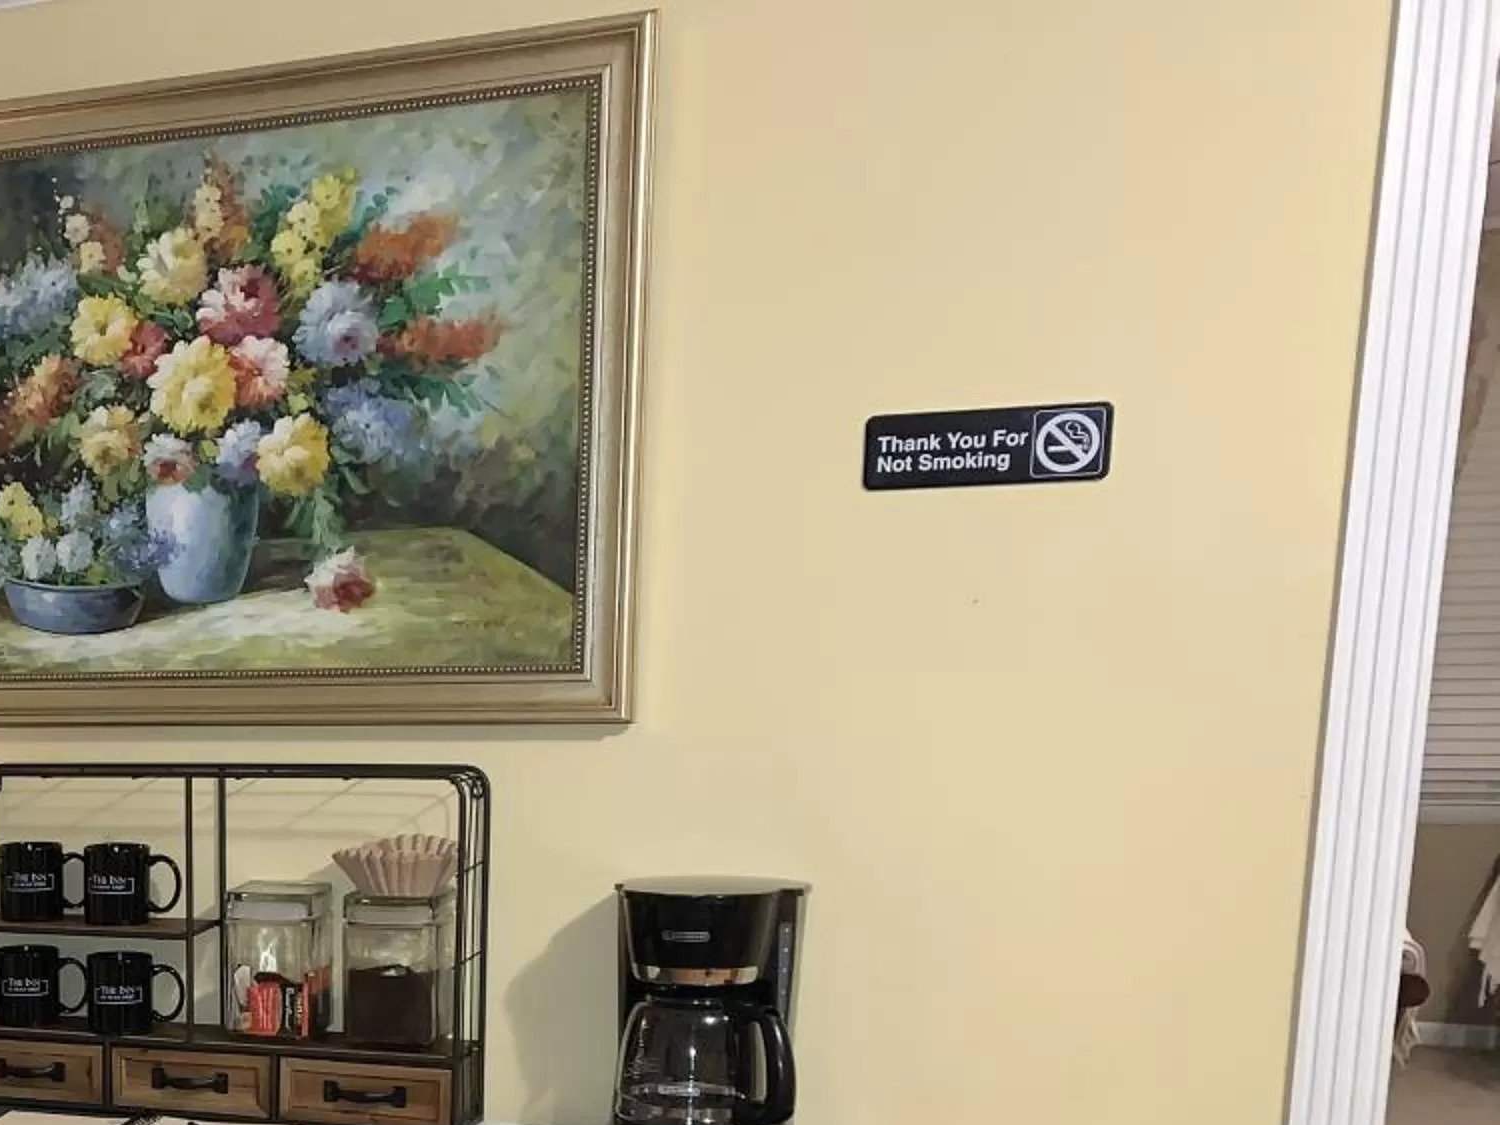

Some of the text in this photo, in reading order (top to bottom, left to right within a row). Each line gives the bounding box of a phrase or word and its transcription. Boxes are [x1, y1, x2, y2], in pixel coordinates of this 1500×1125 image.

[878, 429, 1029, 453] Thank You For
[877, 451, 1011, 473] Not Smoking
